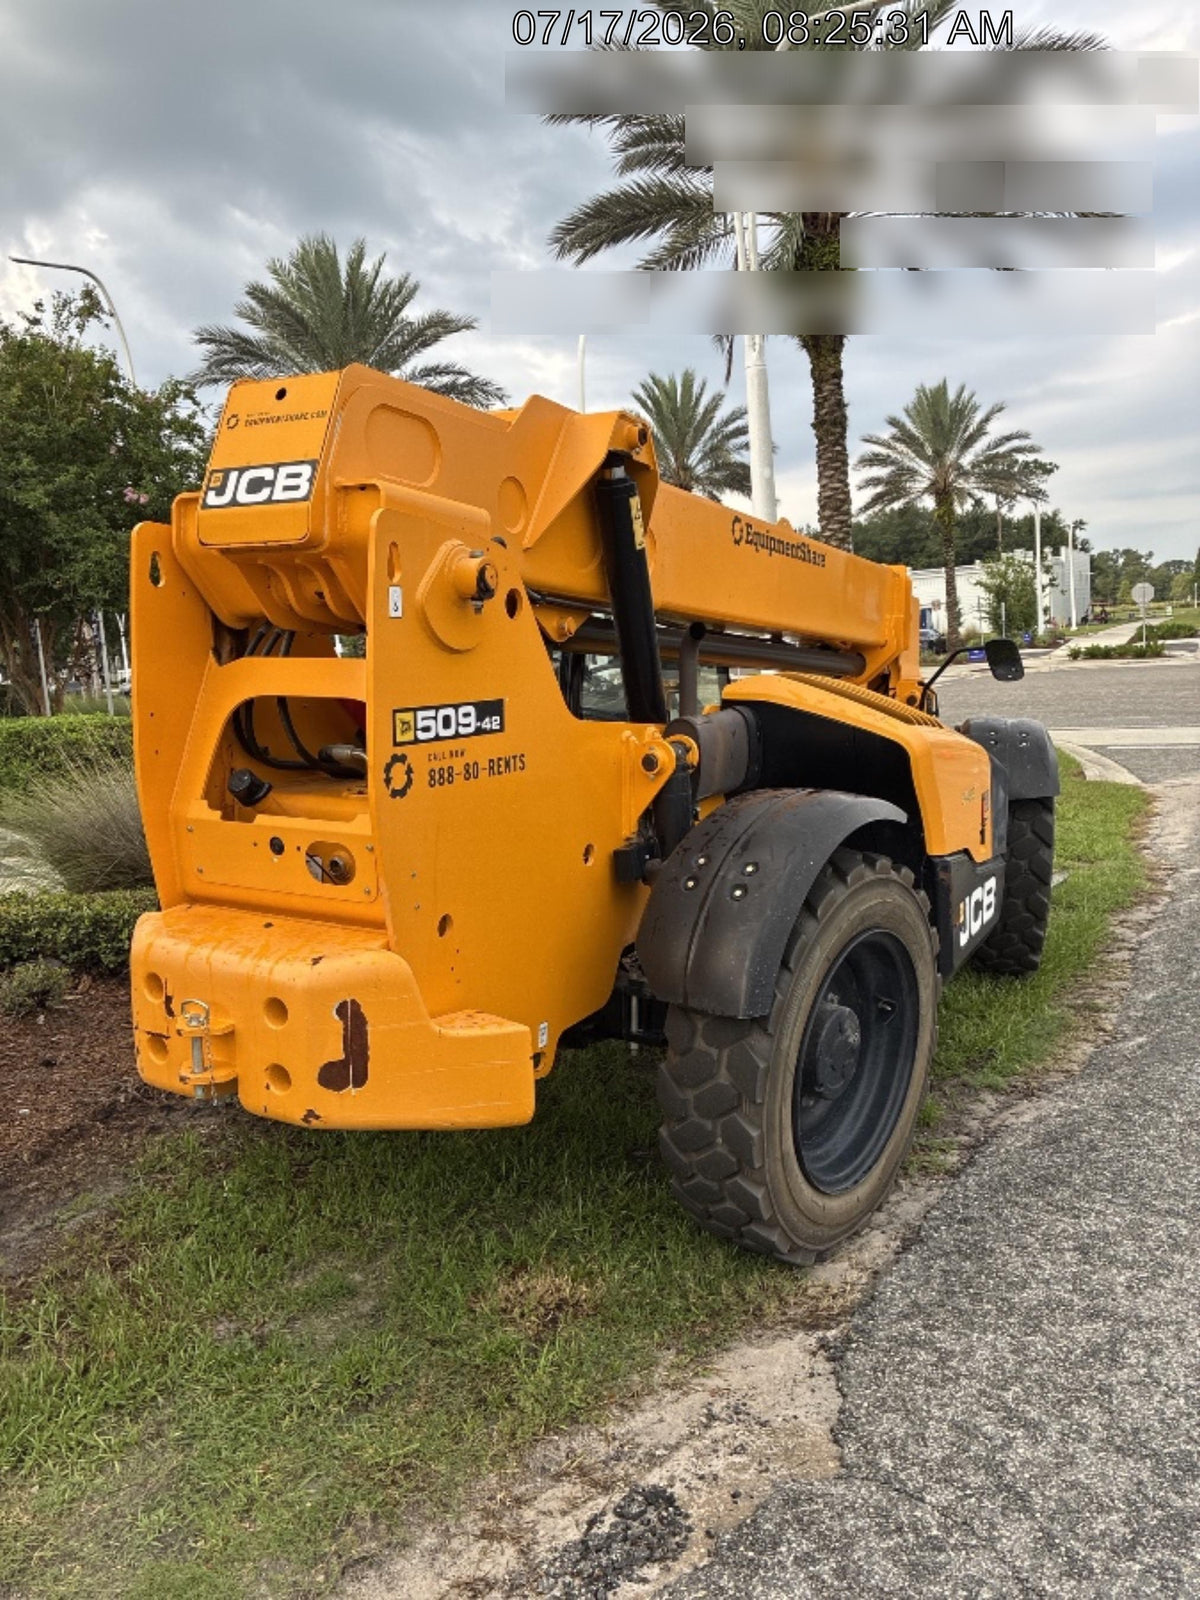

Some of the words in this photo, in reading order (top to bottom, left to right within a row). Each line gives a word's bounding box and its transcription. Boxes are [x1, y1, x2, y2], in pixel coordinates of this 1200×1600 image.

[205, 464, 313, 506] JCB
[745, 522, 826, 568] EquipmentShare
[428, 753, 526, 788] 888-80-RENTS
[959, 876, 997, 947] JCB
